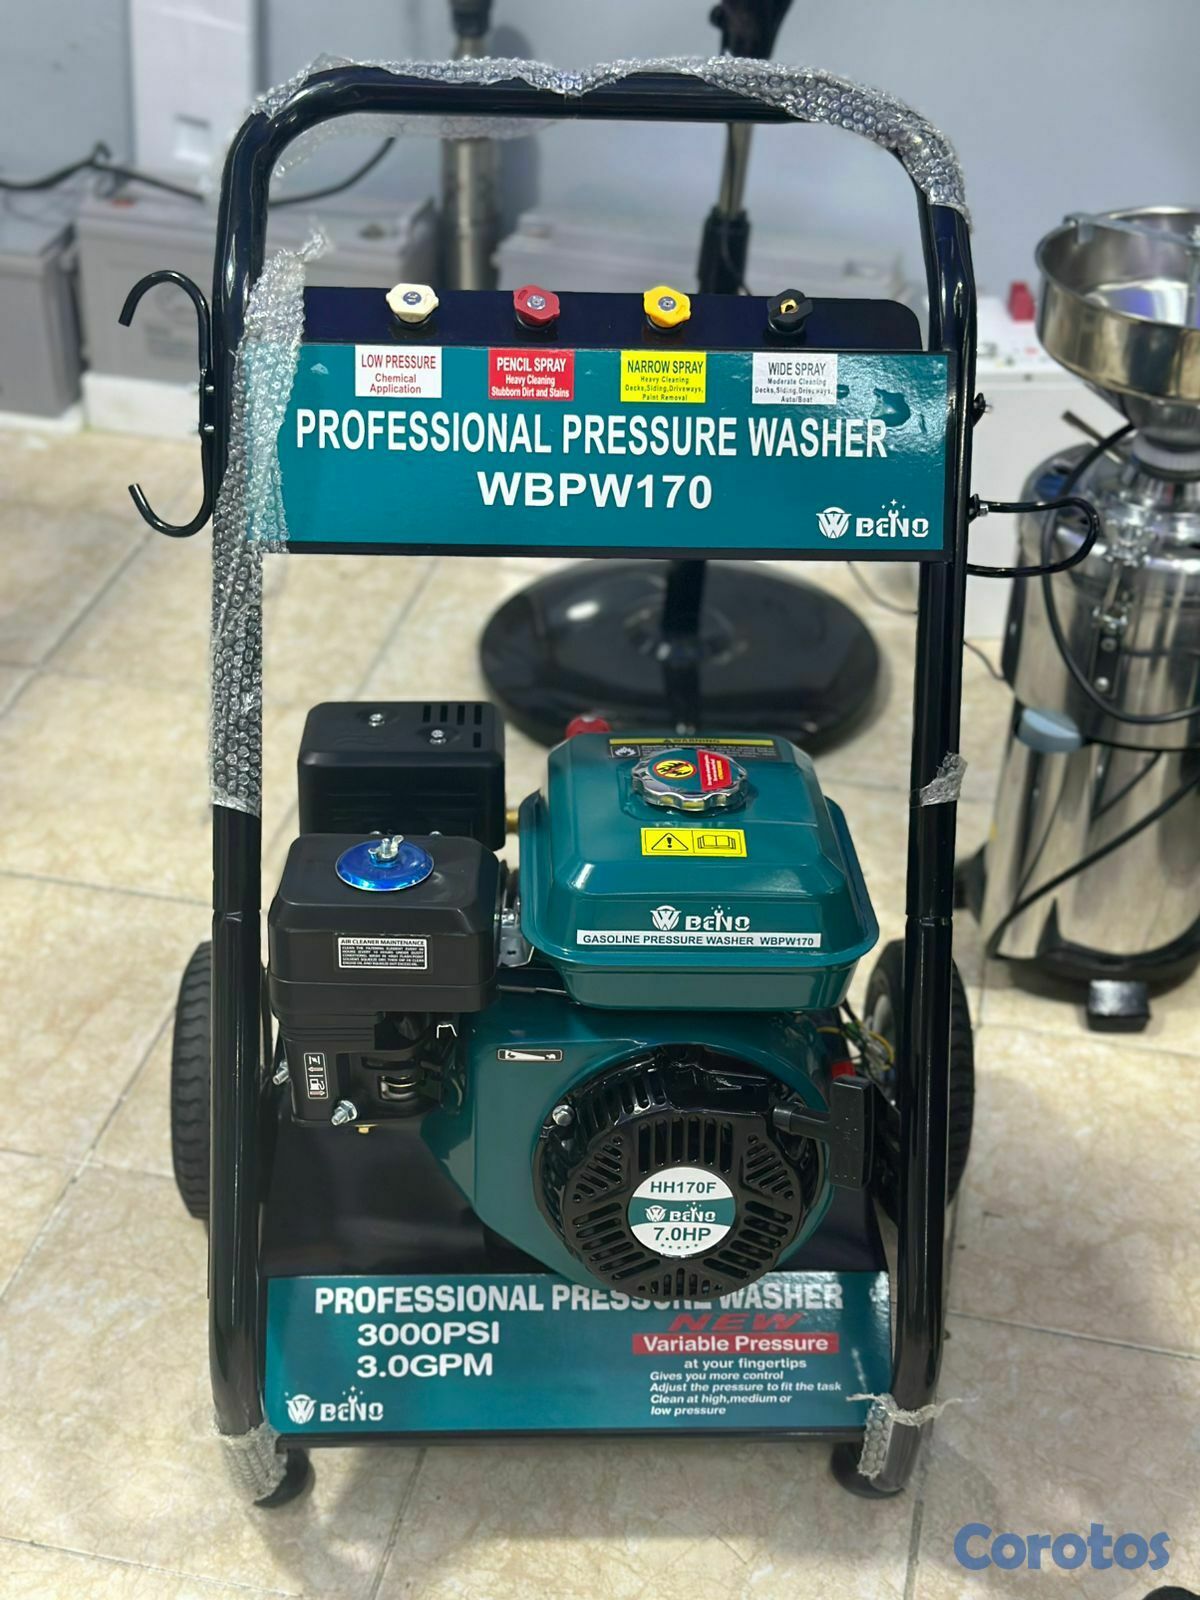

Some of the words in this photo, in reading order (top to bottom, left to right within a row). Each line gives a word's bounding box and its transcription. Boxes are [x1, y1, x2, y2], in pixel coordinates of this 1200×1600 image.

[361, 354, 383, 368] LOW
[385, 355, 436, 369] PRESSURE
[497, 357, 532, 371] PENCIL
[534, 358, 566, 372] SPRAY
[627, 360, 670, 373] NARROW
[672, 361, 703, 374] SPRAY
[768, 362, 793, 375] WIDE
[795, 363, 826, 376] SPRAY
[375, 373, 417, 383] Chemical
[506, 374, 525, 386] Heavy
[527, 375, 555, 386] Cleaning
[662, 376, 689, 384] Cleaning
[799, 379, 827, 387] Cleaning
[370, 384, 421, 394] Application
[491, 386, 520, 397] Stubborn
[522, 387, 534, 397] Dirt
[536, 387, 548, 397] and
[550, 388, 570, 398] Stains
[296, 408, 552, 453] PROFESSIONAL
[562, 414, 737, 456] PRESSURE
[748, 418, 888, 459] WASHER
[477, 471, 713, 508] WBPW170
[583, 935, 641, 945] GASOLINE
[643, 936, 703, 946] PRESSURE
[706, 937, 754, 946] WASHER
[760, 937, 814, 947] WBPW170
[650, 1181, 717, 1194] HH170F
[653, 1227, 711, 1241] 7.0HP
[315, 1285, 545, 1314] PROFESSIONAL
[719, 1283, 843, 1310] WASHER
[668, 1313, 800, 1332] NEW
[357, 1321, 499, 1346] 3000PSI
[643, 1336, 729, 1352] Variable
[735, 1335, 829, 1351] Pressure
[357, 1353, 493, 1378] 3.0GPM
[684, 1359, 699, 1369] at
[702, 1359, 735, 1371] your
[738, 1357, 807, 1371] fingertips
[650, 1371, 683, 1381] Gives
[685, 1373, 707, 1383] you
[709, 1373, 740, 1381] more
[742, 1371, 784, 1380] control
[650, 1383, 688, 1393] Adjust
[690, 1383, 709, 1392] the
[712, 1384, 764, 1394] pressure
[767, 1383, 779, 1391] to
[780, 1382, 793, 1391] fit
[795, 1382, 815, 1391] the
[817, 1382, 842, 1391] task
[650, 1394, 684, 1404] Clean
[686, 1395, 699, 1404] at
[701, 1394, 776, 1405] high,medium
[779, 1395, 793, 1403] or
[650, 1406, 672, 1416] low
[674, 1407, 727, 1417] pressure
